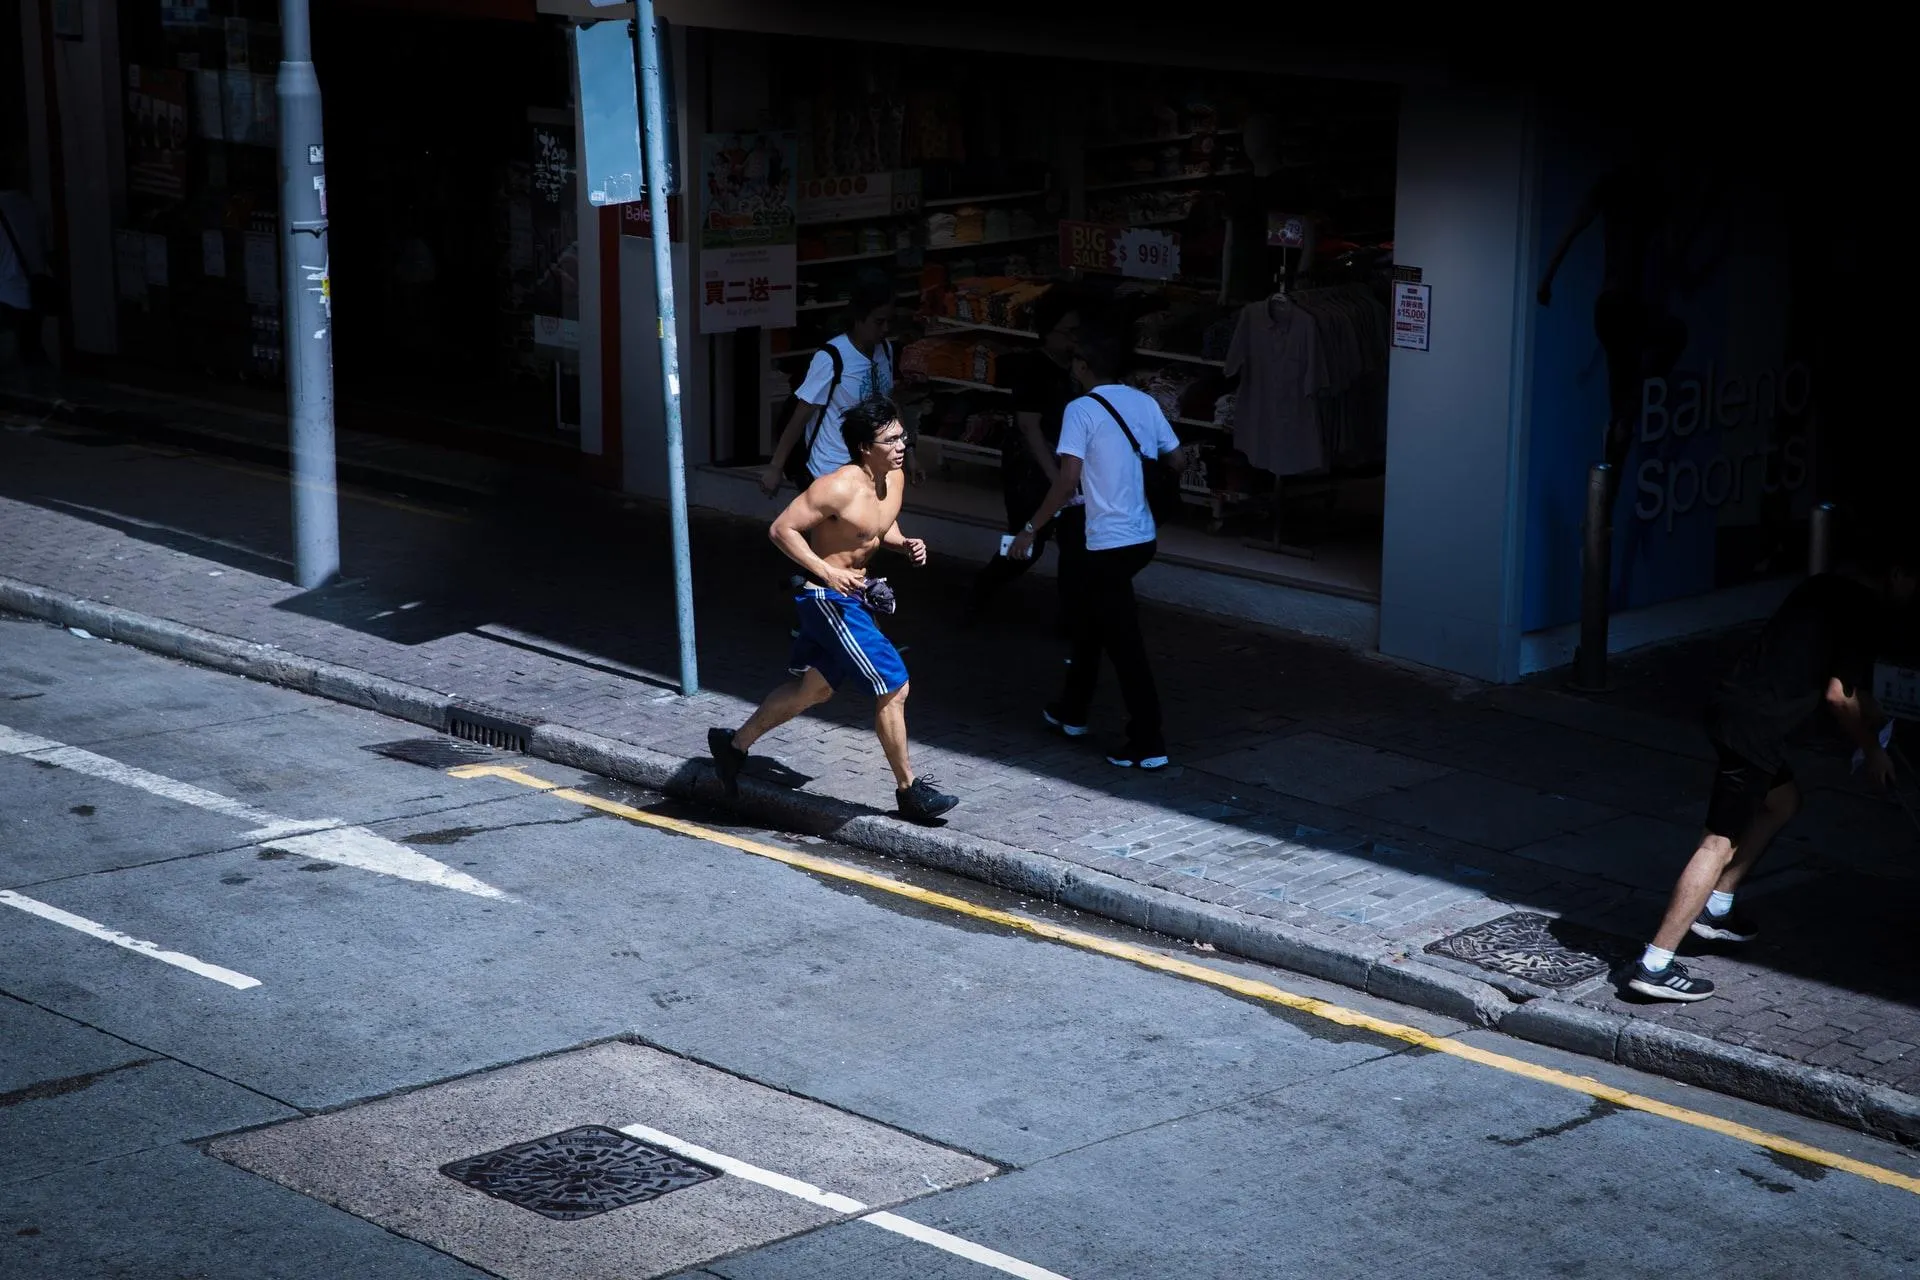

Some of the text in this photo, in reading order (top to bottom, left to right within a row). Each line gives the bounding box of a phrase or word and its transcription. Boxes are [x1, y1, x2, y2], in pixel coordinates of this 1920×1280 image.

[626, 205, 651, 222] Bale
[1072, 249, 1108, 268] SALE
[1138, 244, 1158, 264] 99
[704, 276, 792, 305] 買二送一
[1640, 357, 1812, 444] Baleno
[1634, 432, 1808, 534] sports
